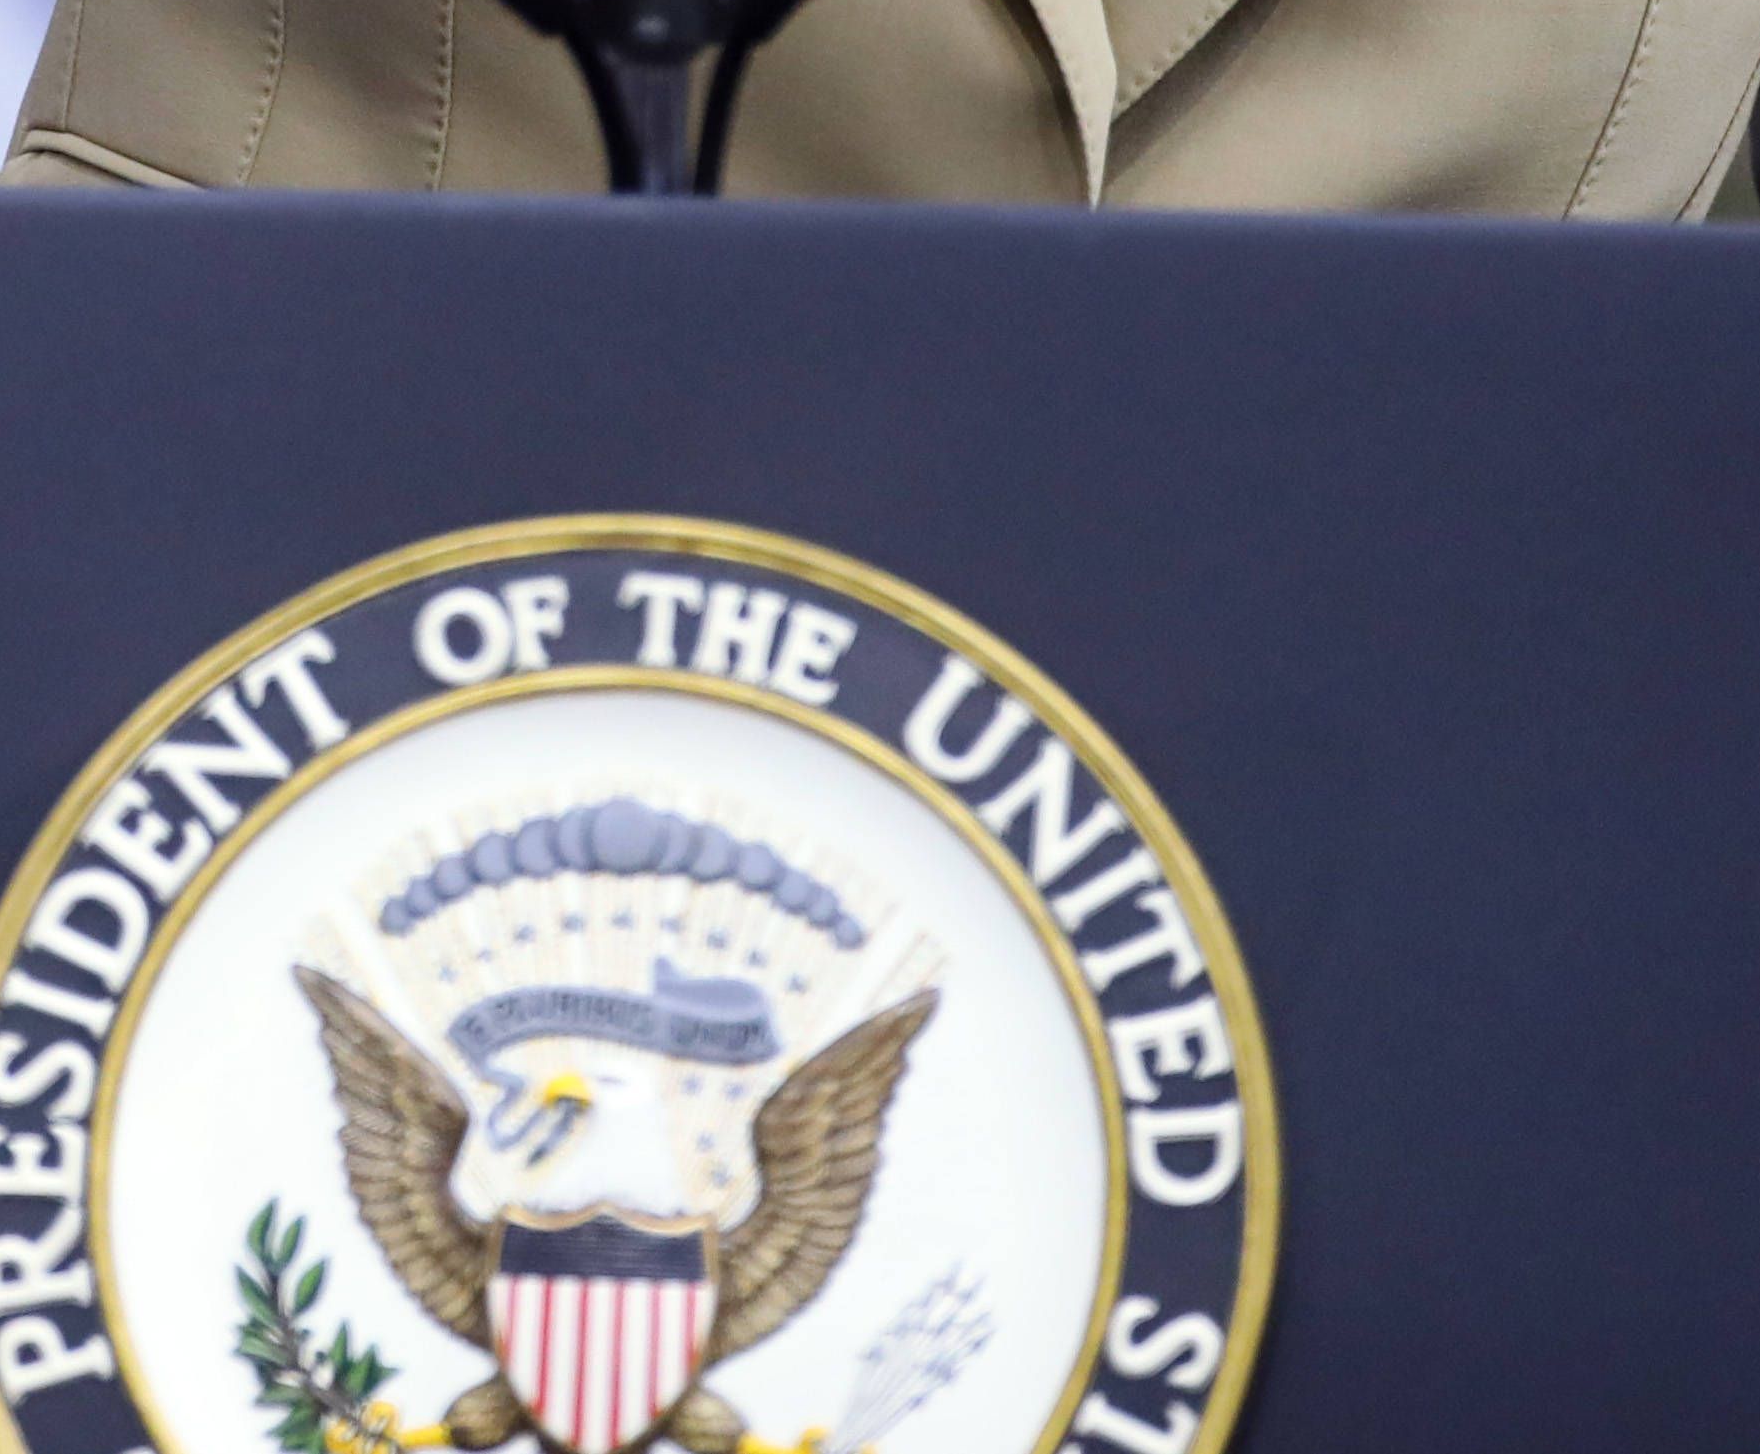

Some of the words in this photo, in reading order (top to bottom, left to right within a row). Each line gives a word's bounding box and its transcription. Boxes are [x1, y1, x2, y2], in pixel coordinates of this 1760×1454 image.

[417, 578, 570, 686] OF
[617, 572, 855, 704] THE
[901, 651, 1247, 1207] UNITED
[1059, 1295, 1228, 1454] ST
